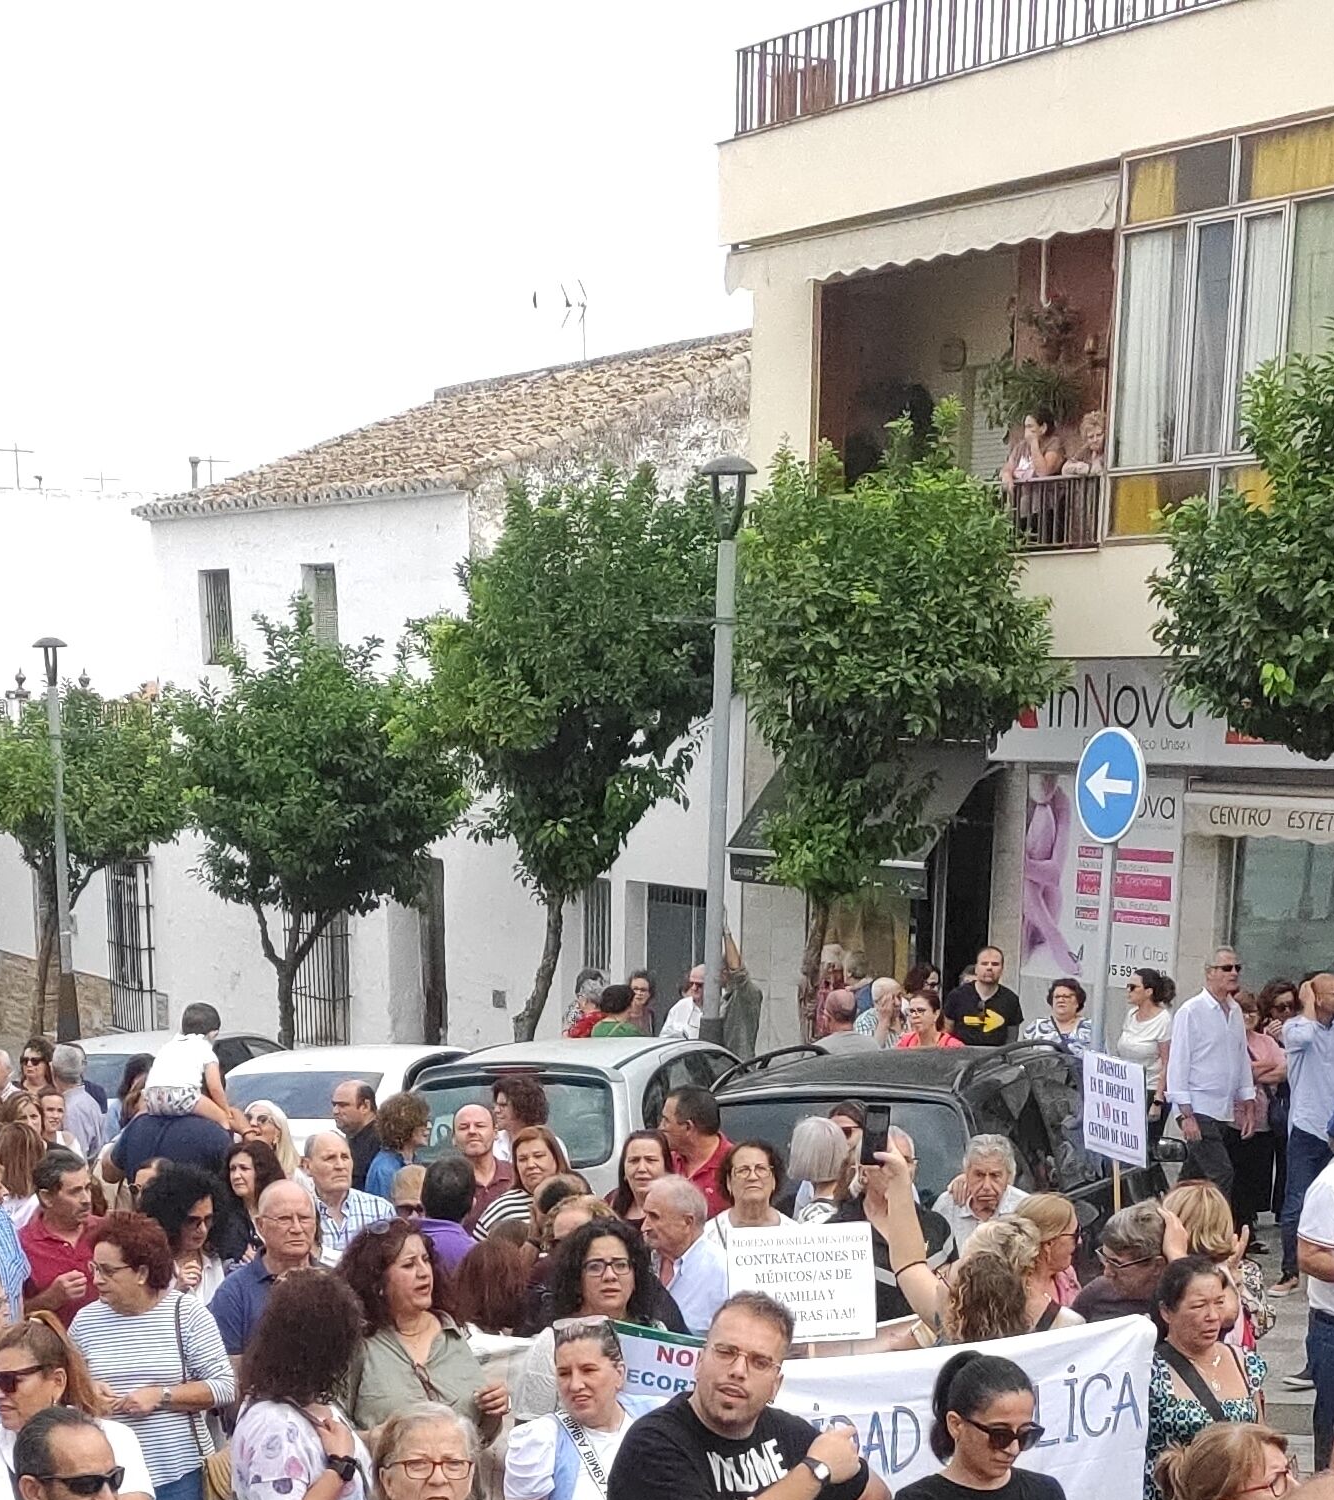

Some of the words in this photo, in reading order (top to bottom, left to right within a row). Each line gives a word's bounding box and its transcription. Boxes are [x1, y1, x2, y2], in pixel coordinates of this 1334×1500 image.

[1209, 805, 1272, 828] CENTRO
[1105, 1081, 1136, 1104] HOSPITAL
[1102, 1102, 1111, 1119] NO
[1088, 1121, 1110, 1142] CENTRO
[1111, 1129, 1119, 1145] DE
[1120, 1130, 1139, 1151] SALUD
[732, 1238, 775, 1249] MORENO
[776, 1236, 815, 1247] BONILLA
[735, 1250, 849, 1267] CONTRATACIONES
[852, 1249, 868, 1261] DE
[754, 1269, 833, 1285] MÉDICOS/AS
[835, 1268, 853, 1280] DE
[774, 1290, 827, 1304] FAMILIA
[827, 1289, 836, 1300] Y
